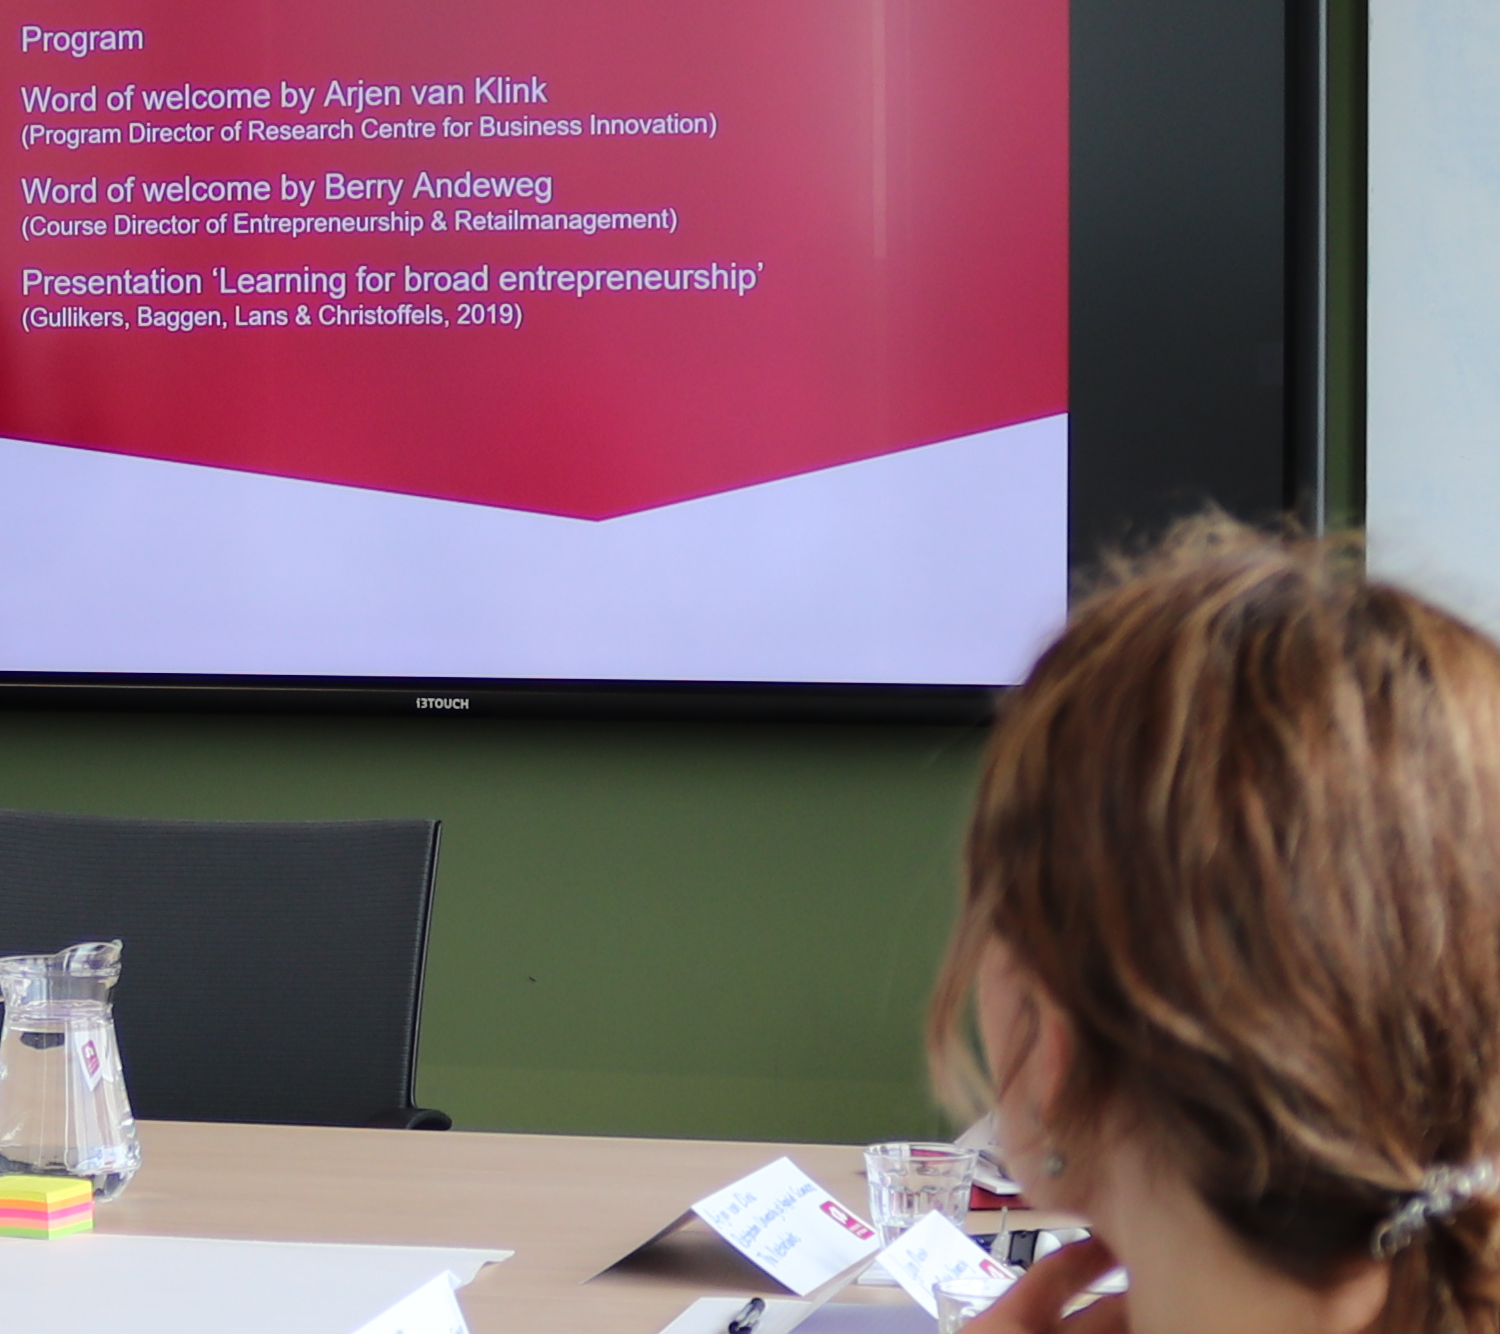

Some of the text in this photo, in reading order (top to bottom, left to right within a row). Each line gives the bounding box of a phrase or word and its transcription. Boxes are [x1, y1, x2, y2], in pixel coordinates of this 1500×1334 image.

[22, 25, 144, 58] Program
[20, 75, 548, 115] Word of welcome by Arjen van Klink
[21, 112, 717, 151] (Program Director of Research Centre for Business Innovation)
[20, 170, 552, 208] Word of welcome by Berry Andeweg
[21, 207, 678, 242] (Course Director of Entrepreneurship & Retailmanagement)
[22, 267, 202, 296] Presentation
[354, 265, 397, 293] for
[404, 264, 489, 292] broad
[21, 302, 523, 333] (Gullikers, Baggen, Lans & Christoffels, 2019)
